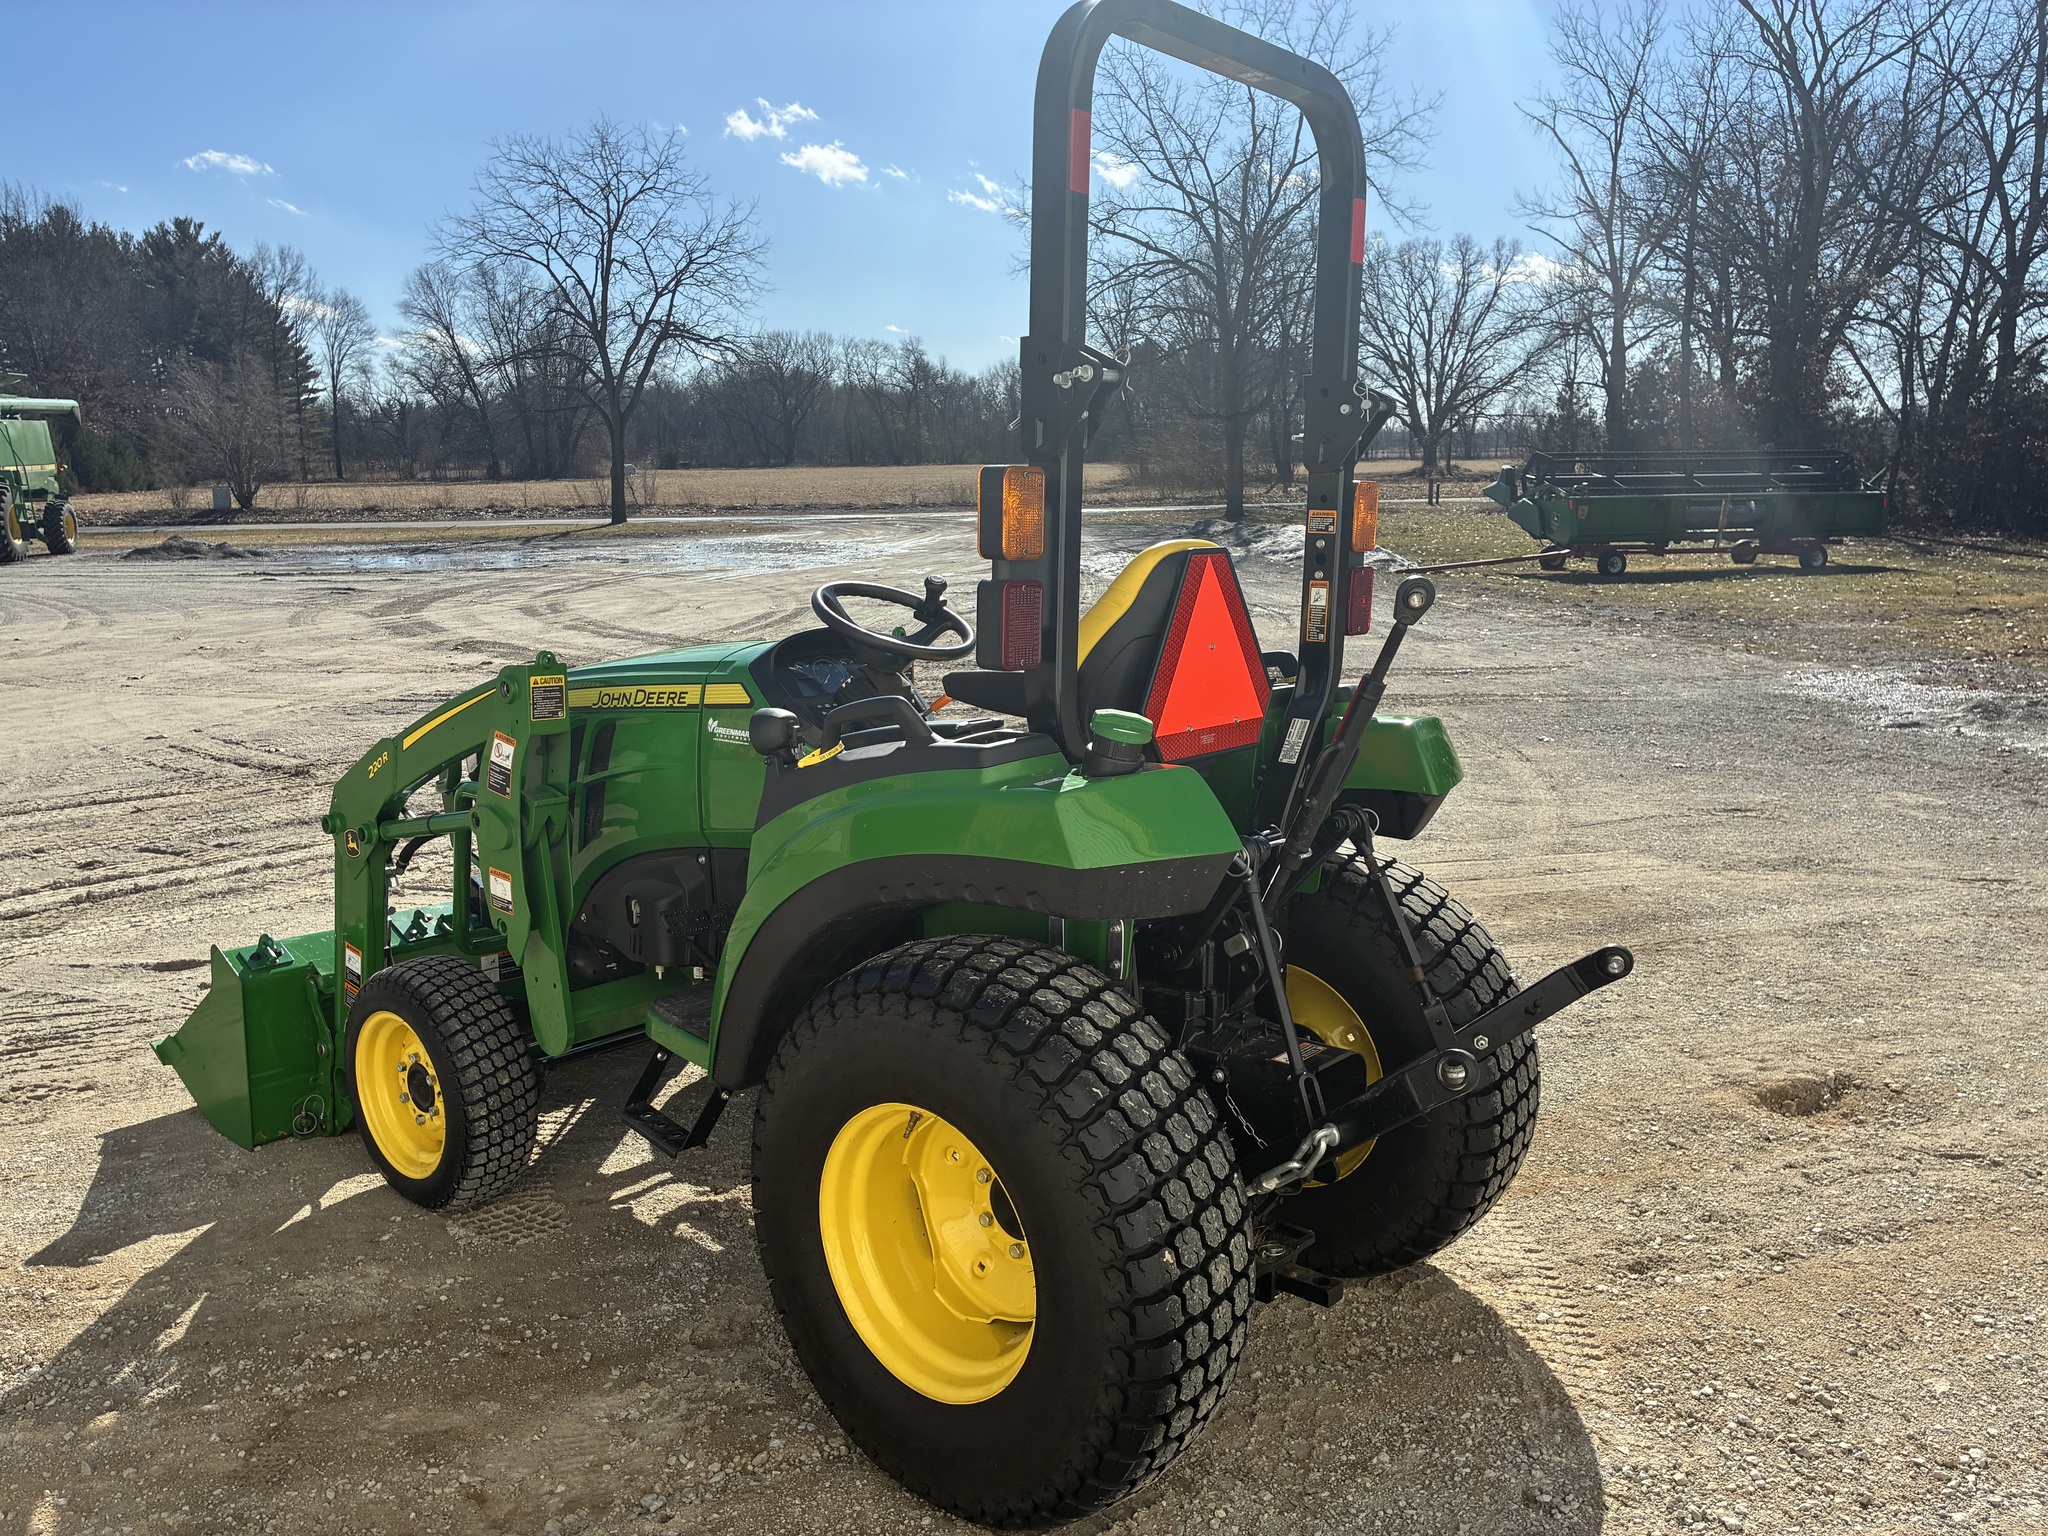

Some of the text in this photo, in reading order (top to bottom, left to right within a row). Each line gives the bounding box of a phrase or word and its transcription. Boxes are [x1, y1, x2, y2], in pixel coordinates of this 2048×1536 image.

[539, 676, 563, 685] CAUTION
[592, 689, 689, 706] JOHN DEERE
[713, 726, 750, 738] GREENMAR
